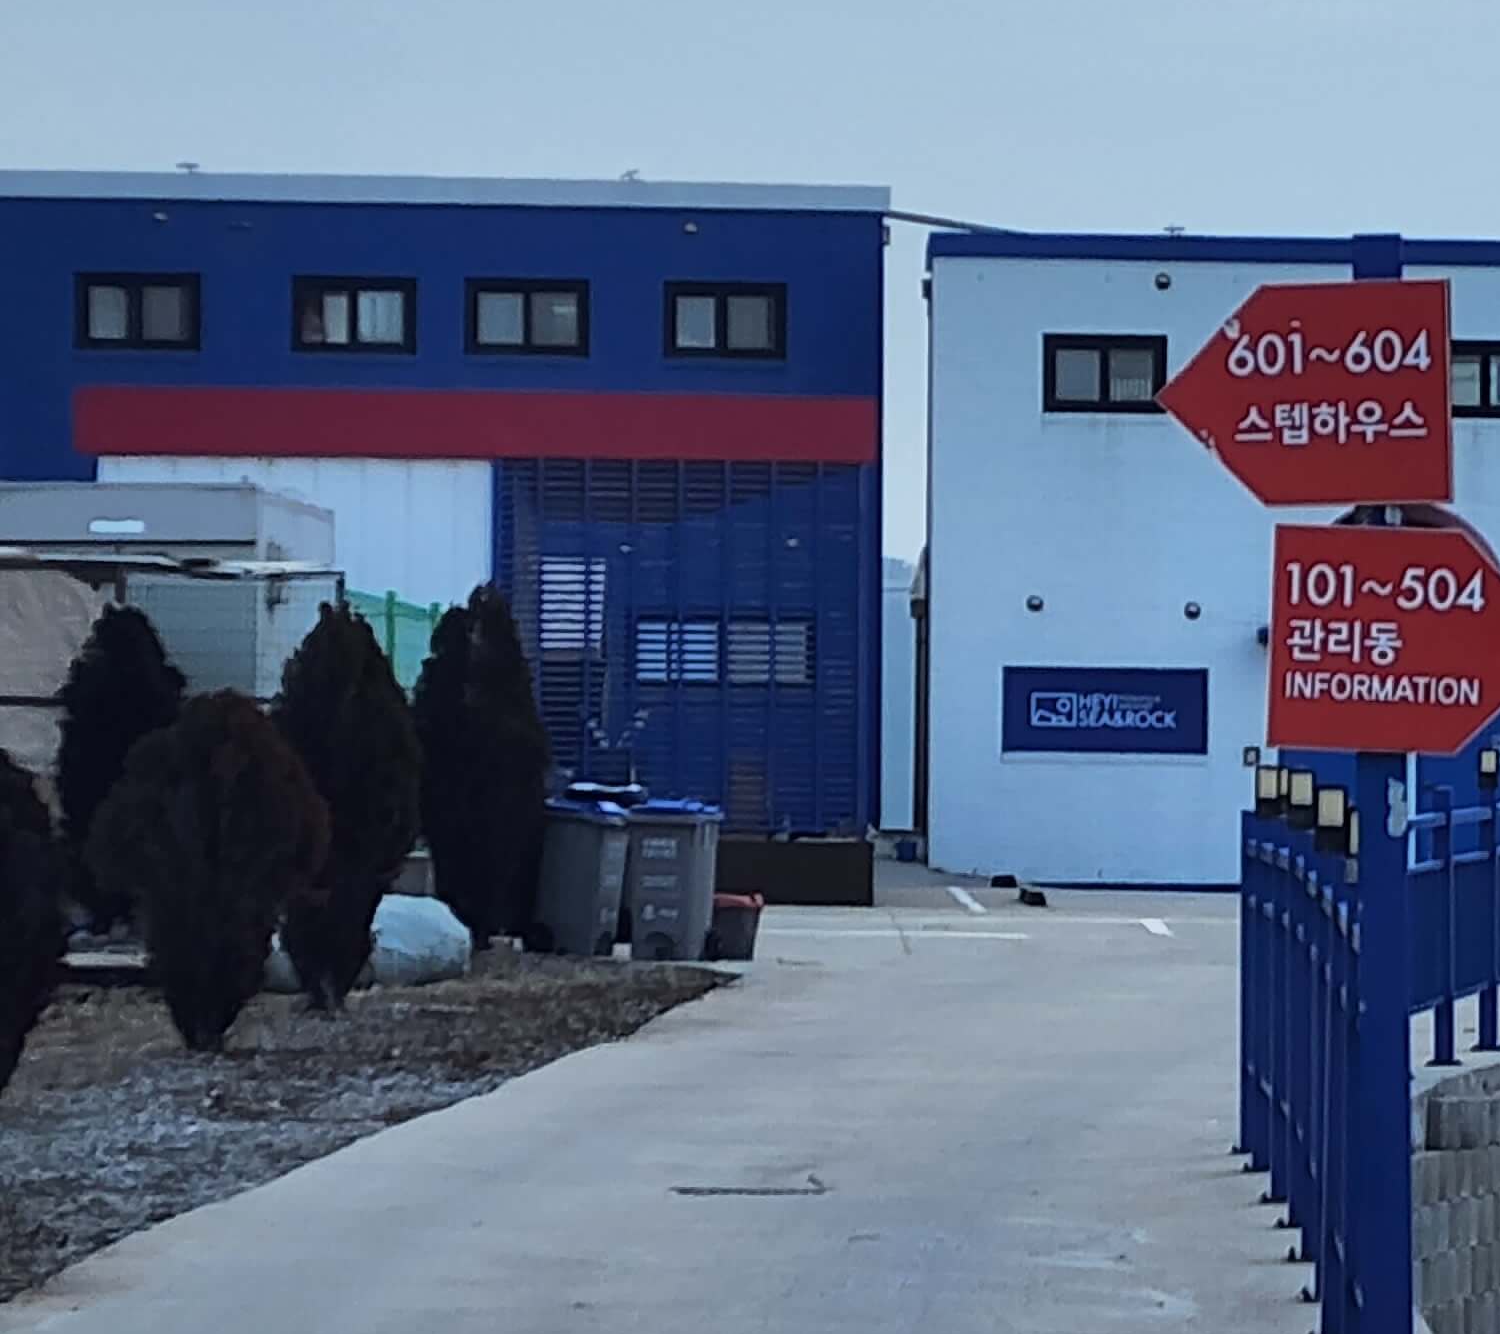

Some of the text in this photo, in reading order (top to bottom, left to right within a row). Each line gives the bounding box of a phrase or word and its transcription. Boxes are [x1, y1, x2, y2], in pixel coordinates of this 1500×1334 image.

[1227, 328, 1432, 377] 601~604
[1233, 399, 1429, 445] 스텝하우스
[1285, 561, 1486, 612] 101~504
[1285, 617, 1404, 667] 관리동
[1284, 670, 1481, 706] INFORMATION
